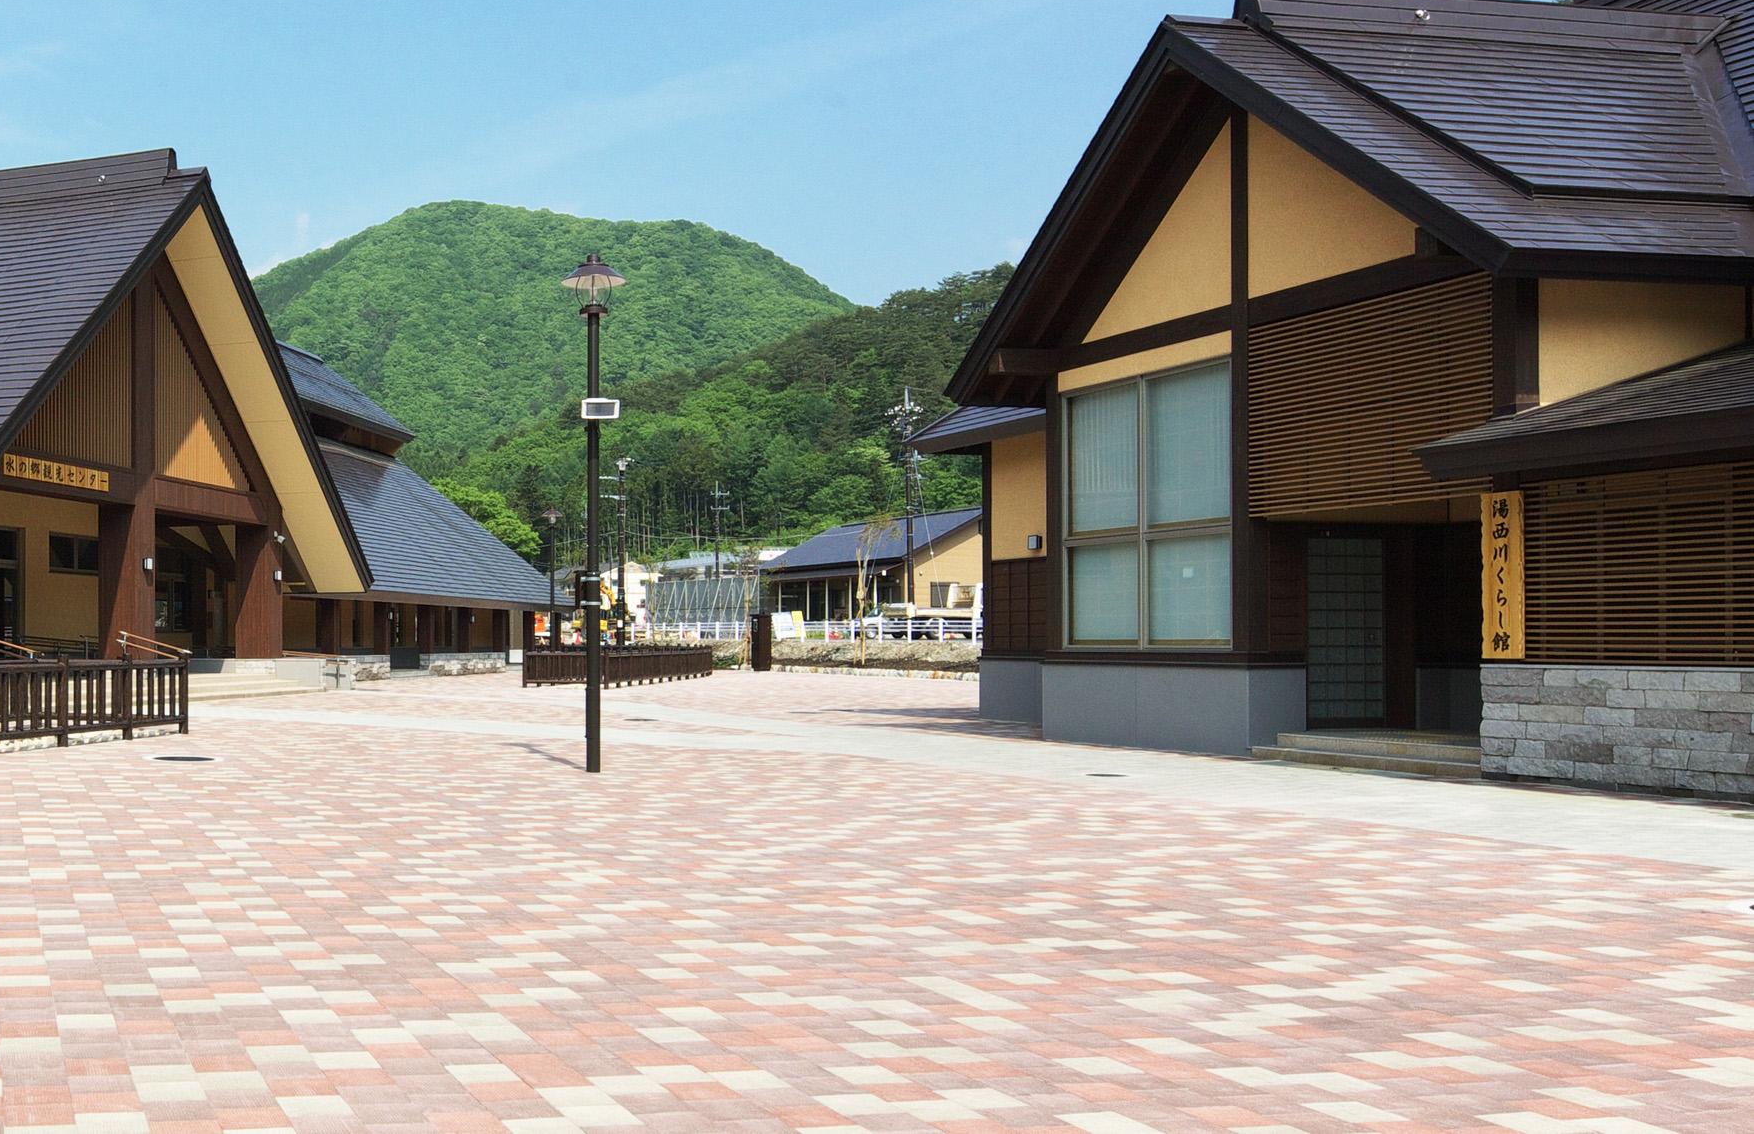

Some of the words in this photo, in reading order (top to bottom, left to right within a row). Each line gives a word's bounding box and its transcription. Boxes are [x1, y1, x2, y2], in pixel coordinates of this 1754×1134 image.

[5, 456, 108, 486] 水の郷観光センター
[1491, 498, 1511, 652] 湯西川くらし館
